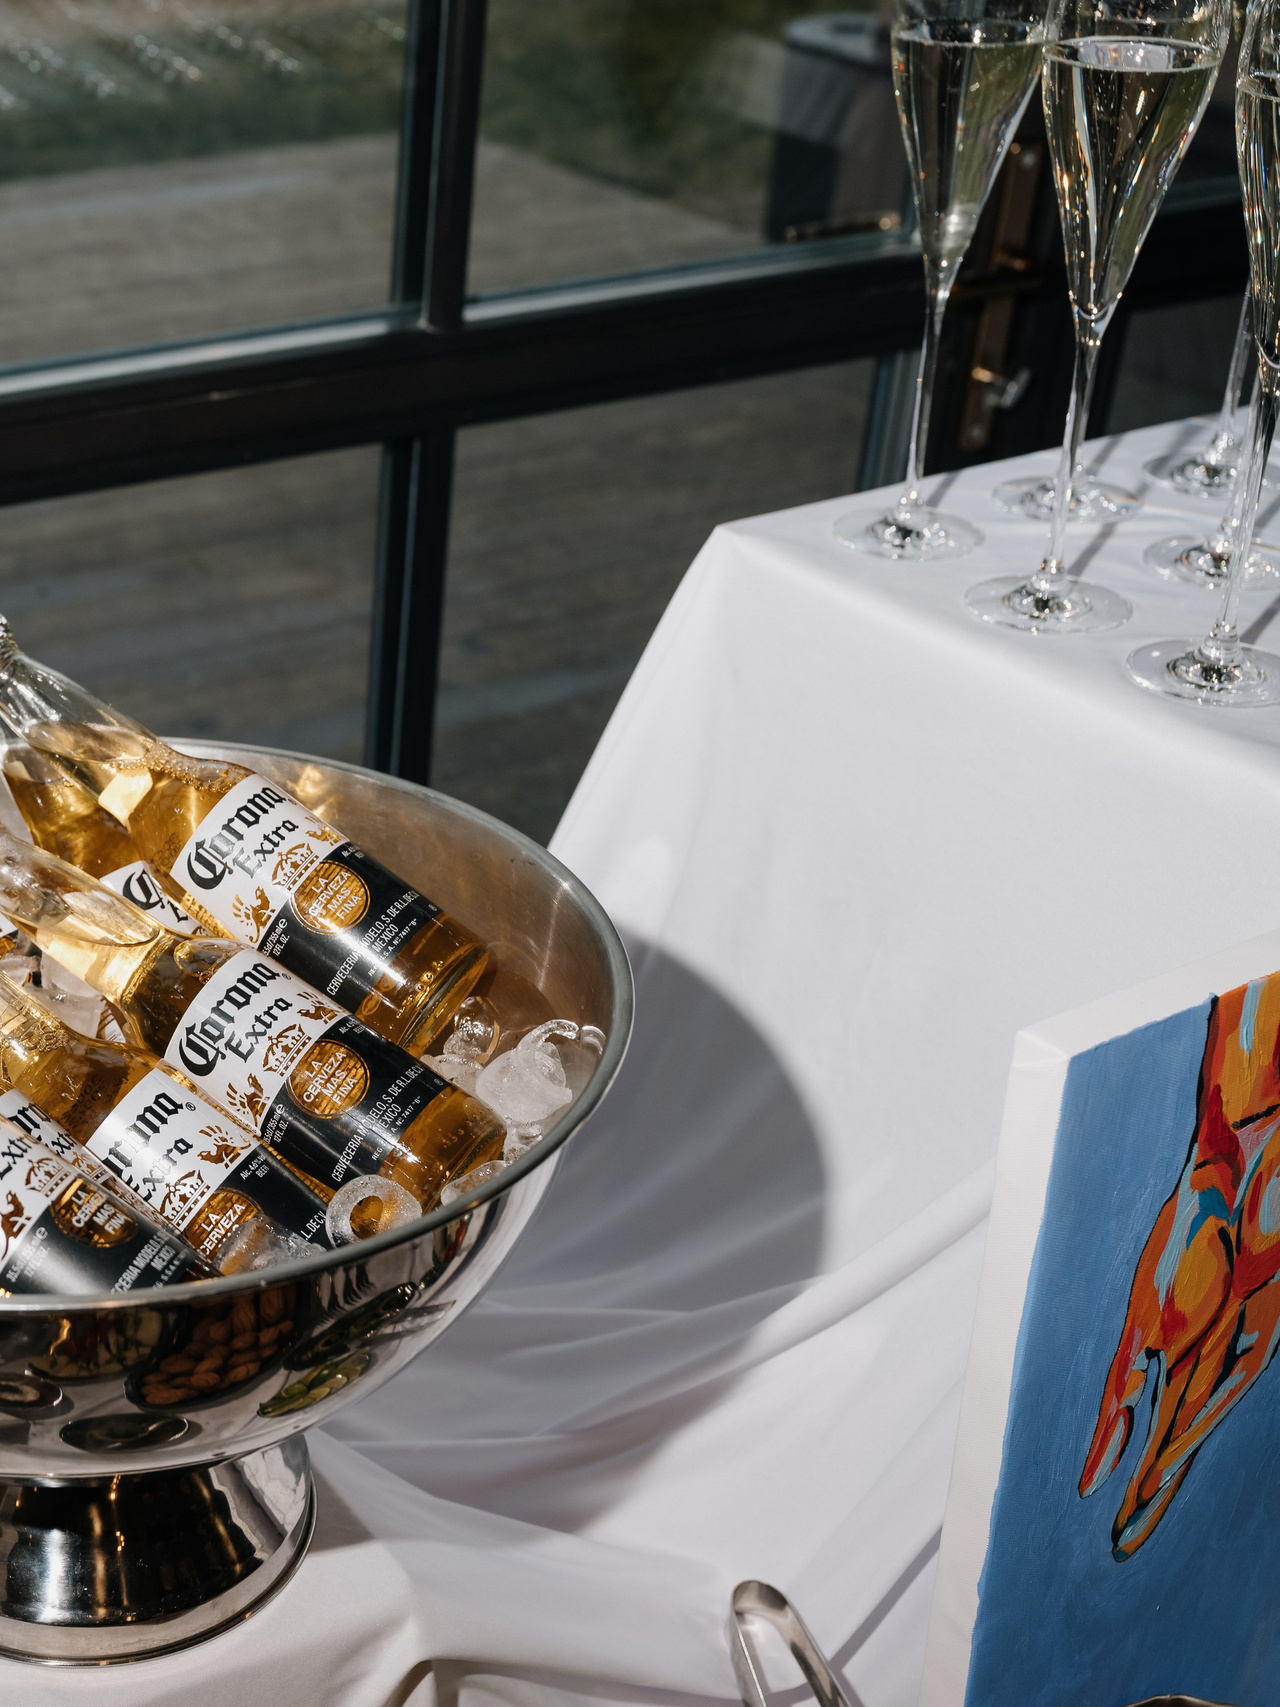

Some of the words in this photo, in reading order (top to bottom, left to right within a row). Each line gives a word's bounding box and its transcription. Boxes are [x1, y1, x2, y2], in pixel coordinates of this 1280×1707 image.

[186, 786, 287, 890] Corona
[232, 818, 299, 878] Extra
[309, 870, 350, 917] CERVEZA
[312, 876, 328, 893] LA
[328, 886, 350, 912] MAS
[337, 894, 360, 919] FINA
[373, 924, 399, 951] MEXICO
[398, 925, 411, 939] 7417
[178, 962, 281, 1077] Corona
[224, 998, 293, 1063] Extra
[303, 1050, 345, 1103] CERVEZA
[306, 1059, 322, 1077] LA
[323, 1069, 346, 1096] MAS
[332, 1075, 357, 1104] FINA
[375, 1103, 401, 1135] MEXICO
[402, 1105, 414, 1119] 7417
[256, 1164, 270, 1178] BEER
[331, 1133, 363, 1182] CERVECERIA
[71, 1189, 89, 1206] LA
[93, 1203, 115, 1226] MAS
[104, 1211, 128, 1235] FINA
[201, 1211, 220, 1231] LA
[150, 1244, 176, 1271] MEXICO
